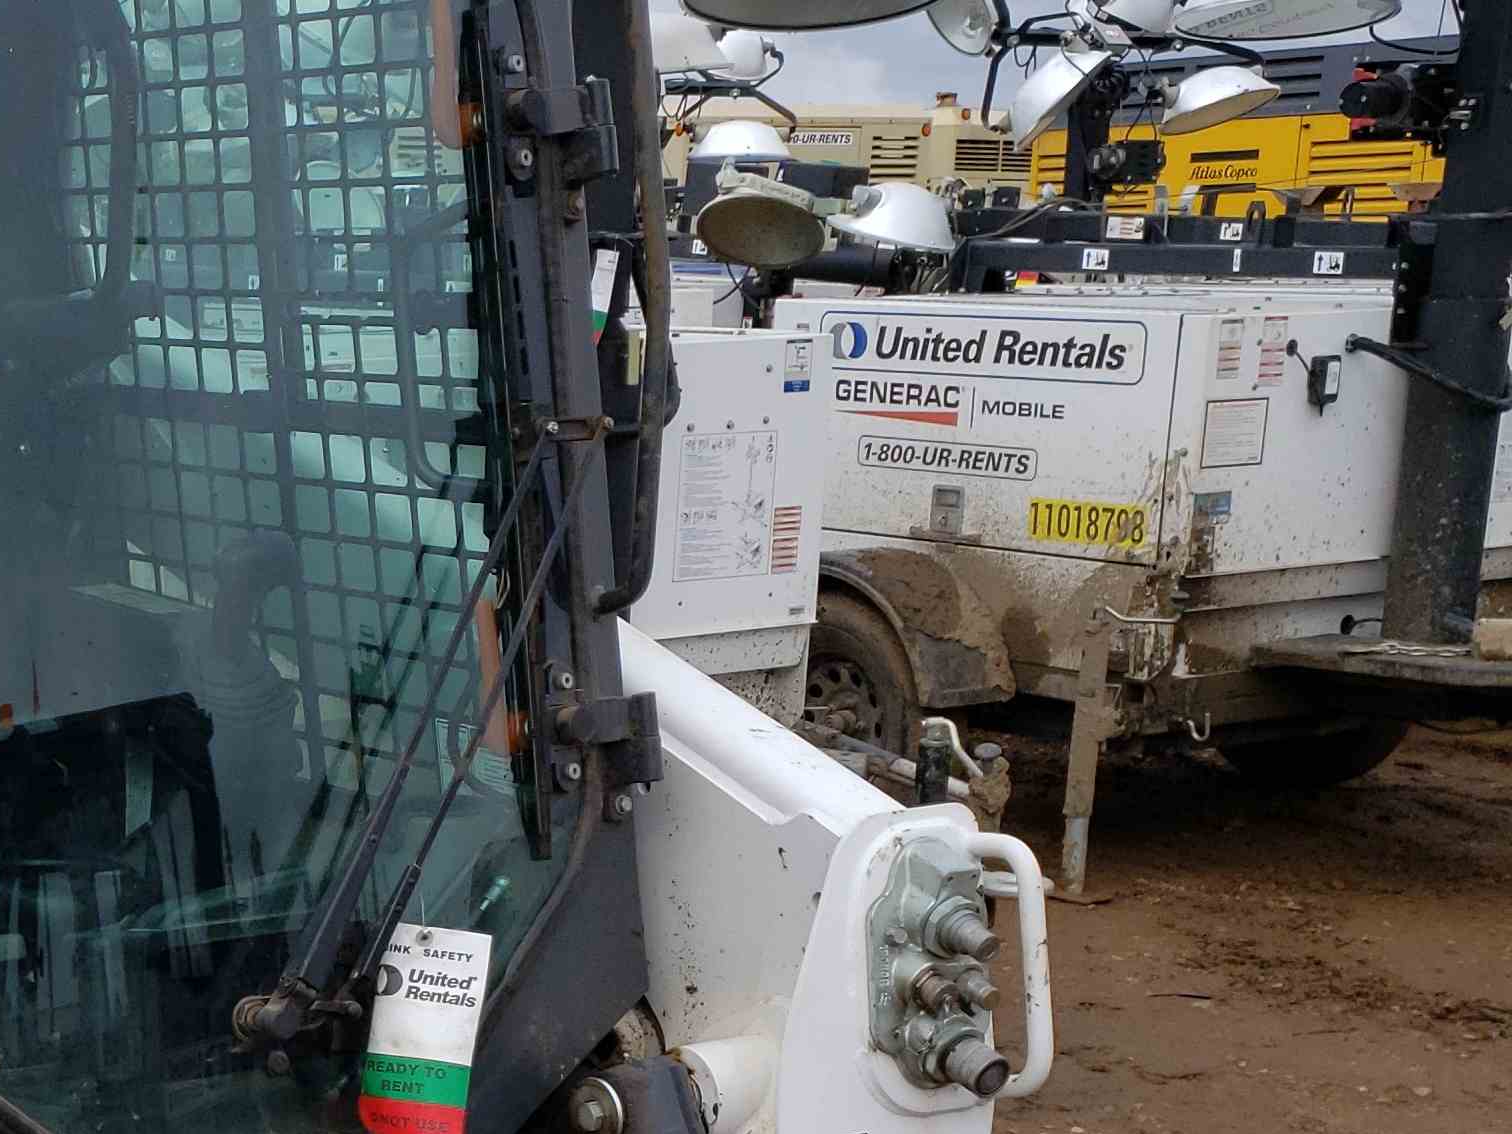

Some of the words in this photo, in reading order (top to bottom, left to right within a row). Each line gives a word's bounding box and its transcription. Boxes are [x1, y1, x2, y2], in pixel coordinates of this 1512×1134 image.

[875, 325, 987, 365] United
[993, 329, 1127, 371] Rentals
[835, 379, 961, 409] GENERAC
[981, 399, 1065, 421] MOBILE
[863, 441, 1031, 475] 1-800-UR-RENTS
[423, 948, 474, 963] SAFETY
[408, 967, 471, 990] United
[404, 984, 478, 1008] Rentals
[367, 1059, 419, 1077] READY
[424, 1065, 447, 1080] TO
[380, 1079, 425, 1095] RENT
